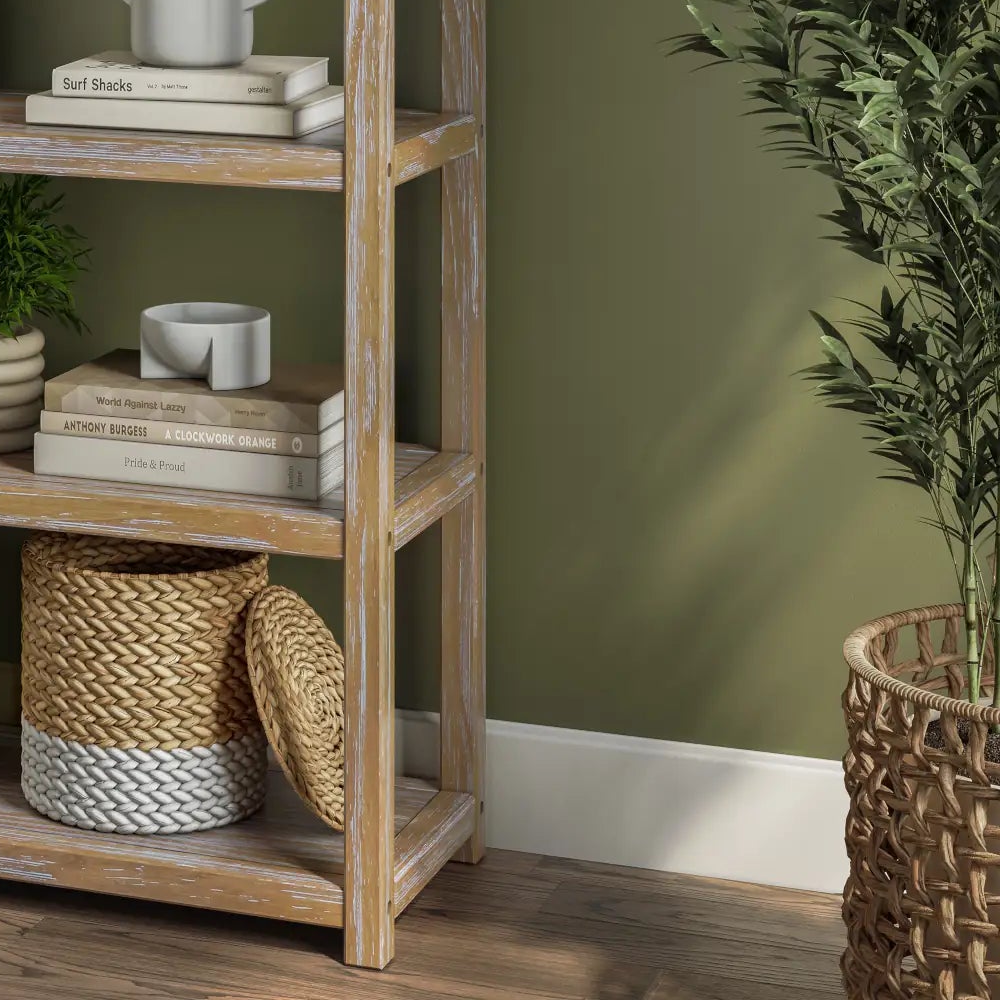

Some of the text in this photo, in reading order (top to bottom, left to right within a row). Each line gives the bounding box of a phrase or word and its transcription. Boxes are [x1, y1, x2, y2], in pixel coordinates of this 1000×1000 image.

[63, 77, 87, 91] Surf
[91, 78, 132, 92] Shacks
[96, 396, 186, 413] World Against Lazzy
[63, 420, 277, 449] ANTHONY BURGESS A CLOCKWORK ORANGE
[124, 457, 186, 473] Pride & Proud
